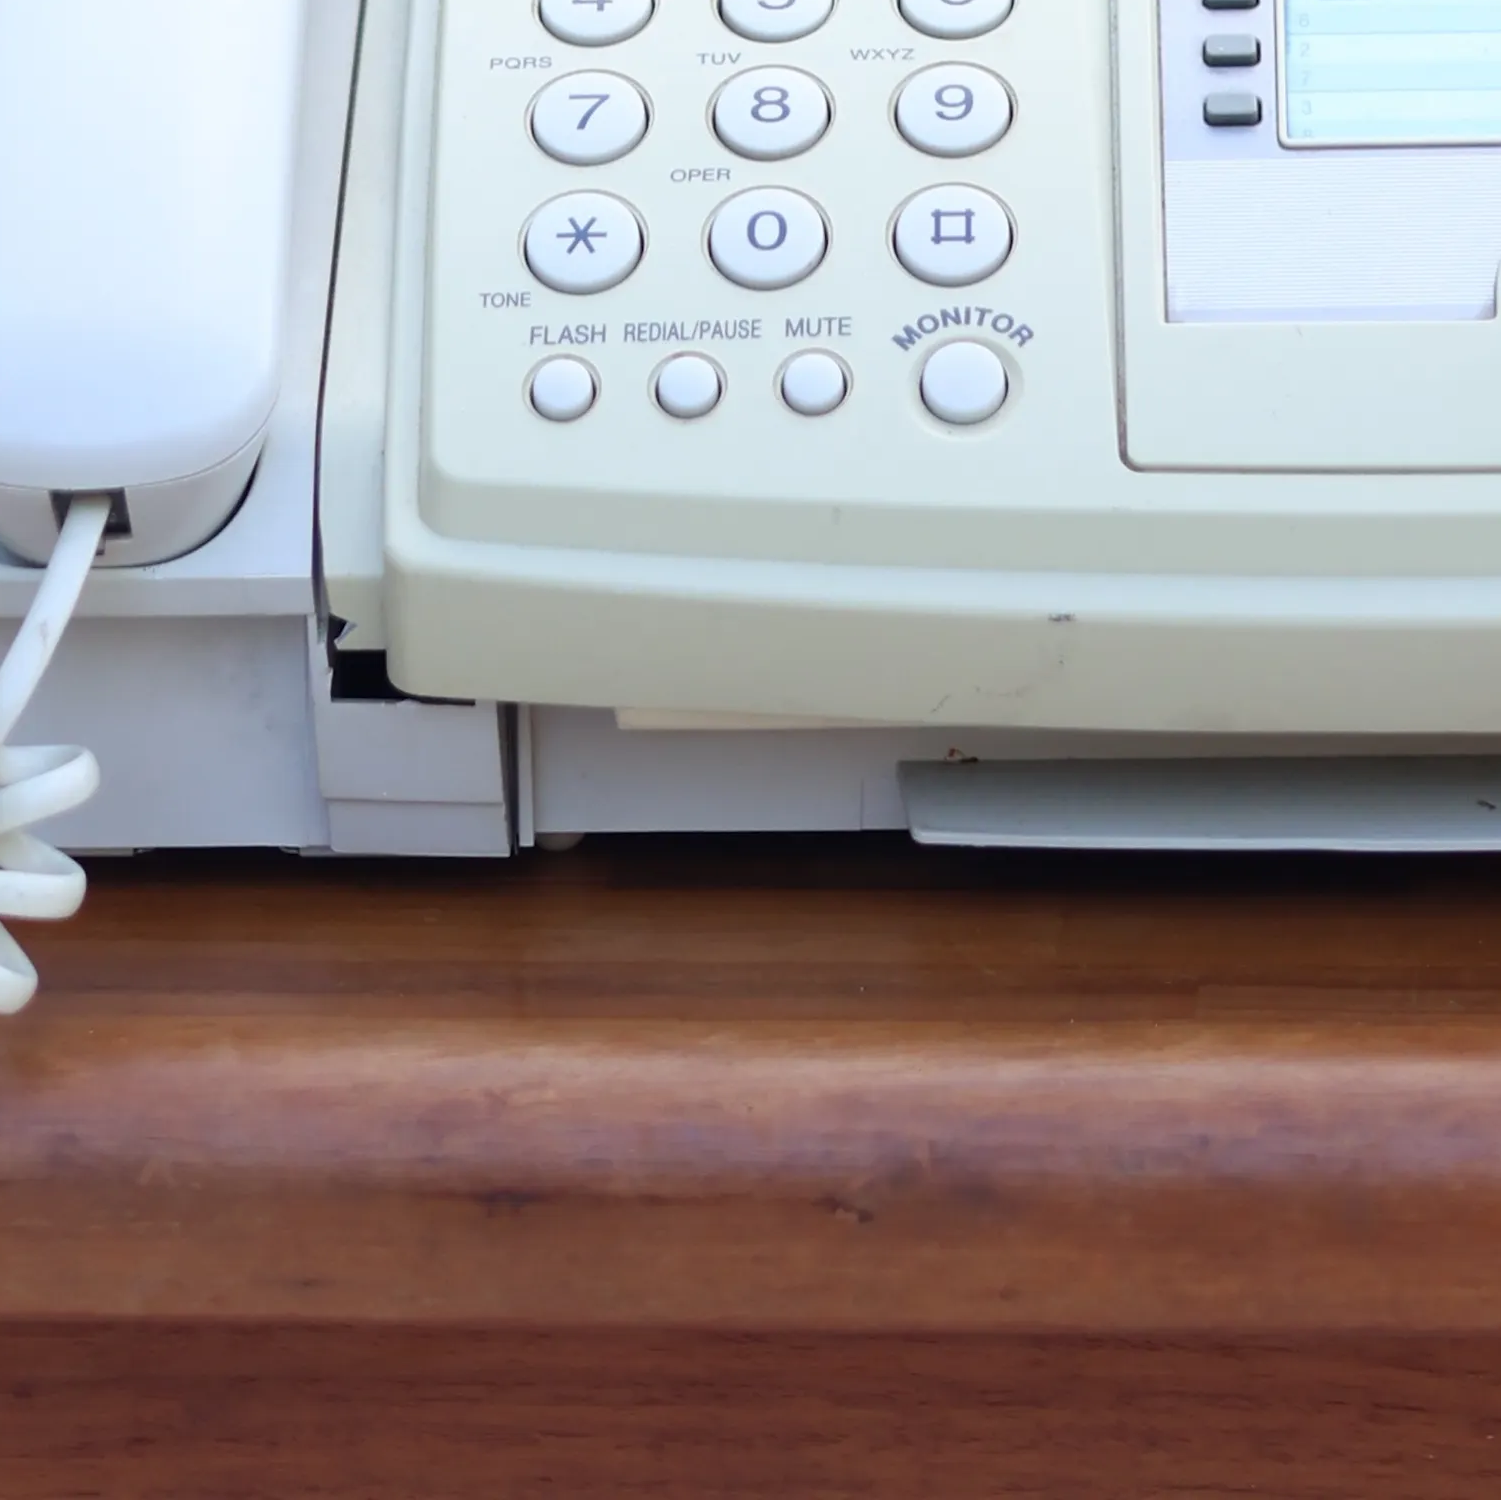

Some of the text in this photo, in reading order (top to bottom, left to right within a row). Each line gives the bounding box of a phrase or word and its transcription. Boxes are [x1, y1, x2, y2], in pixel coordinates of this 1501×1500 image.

[489, 56, 553, 70] PQRS
[697, 52, 742, 65] TUV
[849, 48, 915, 60] WXYZ
[566, 94, 610, 131] 7
[750, 86, 791, 123] 8
[934, 83, 975, 121] 9
[670, 168, 732, 182] OPER
[746, 210, 787, 251] 0
[480, 292, 532, 308] TONE
[529, 324, 608, 345] FLASH
[623, 319, 762, 343] REDIAL/PAUSE
[784, 317, 853, 337] MUTE
[892, 306, 1035, 351] MONITOR
